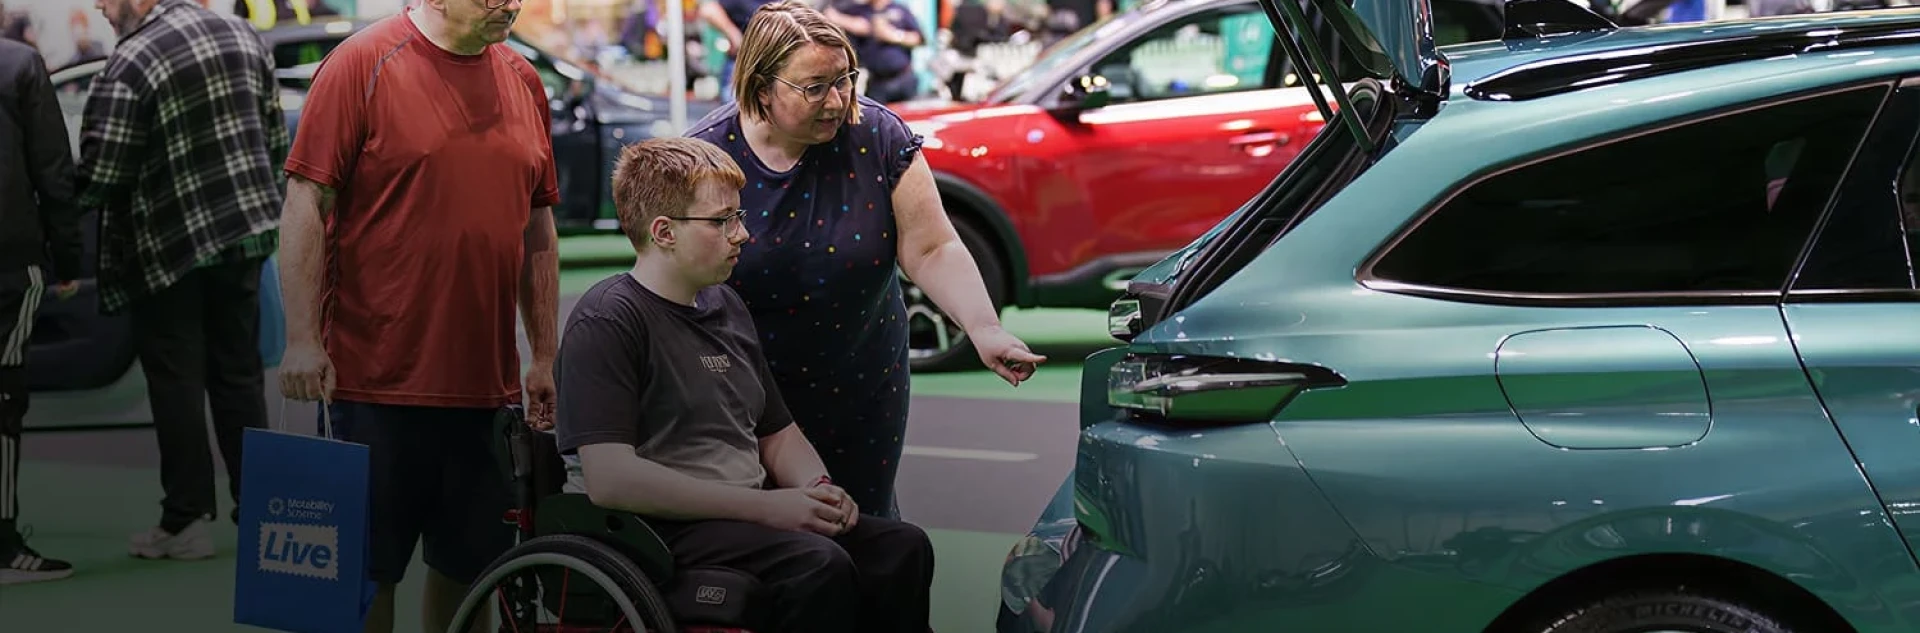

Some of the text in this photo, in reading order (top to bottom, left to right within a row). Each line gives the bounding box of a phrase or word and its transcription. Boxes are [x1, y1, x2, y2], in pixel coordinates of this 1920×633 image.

[288, 498, 334, 513] Motability
[264, 532, 331, 569] Live
[1636, 604, 1748, 628] MICHELIN
